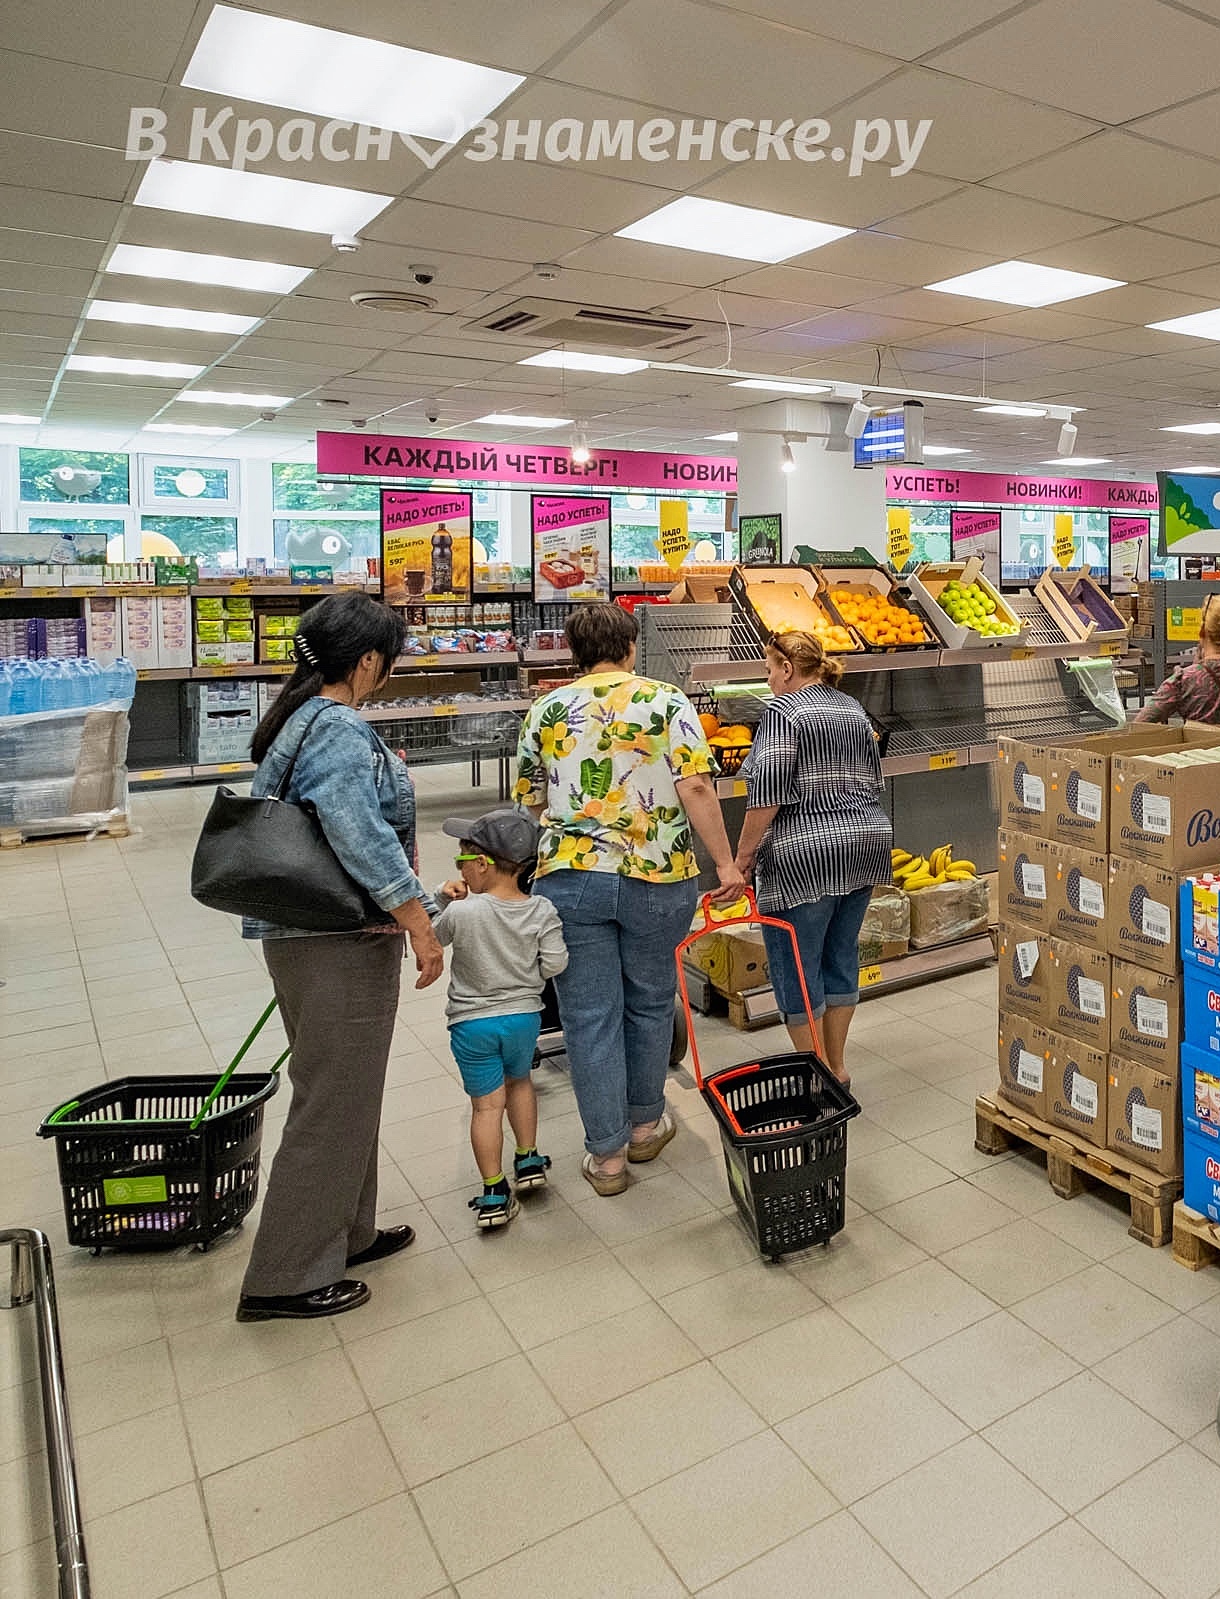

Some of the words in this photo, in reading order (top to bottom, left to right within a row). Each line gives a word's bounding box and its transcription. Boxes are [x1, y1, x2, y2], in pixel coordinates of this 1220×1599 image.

[363, 444, 498, 473] КАЖДЫЙ
[505, 453, 619, 478] ЧЕТВЕРГ!
[663, 461, 738, 482] НОВИН
[893, 475, 960, 494] УСПЕТЬ!
[1006, 481, 1082, 499] НОВИНКИ!
[1107, 487, 1158, 504] КАЖДЫ
[386, 509, 419, 524] НАДО
[421, 501, 465, 518] УСПЕТЬ!
[537, 513, 566, 526] НАДО
[567, 504, 605, 520] УСПЕТЬ!
[662, 528, 681, 537] НАДО
[955, 525, 973, 536] НАДО
[662, 536, 687, 546] УСПЕТЬ
[662, 543, 691, 555] КУПИТЬ!
